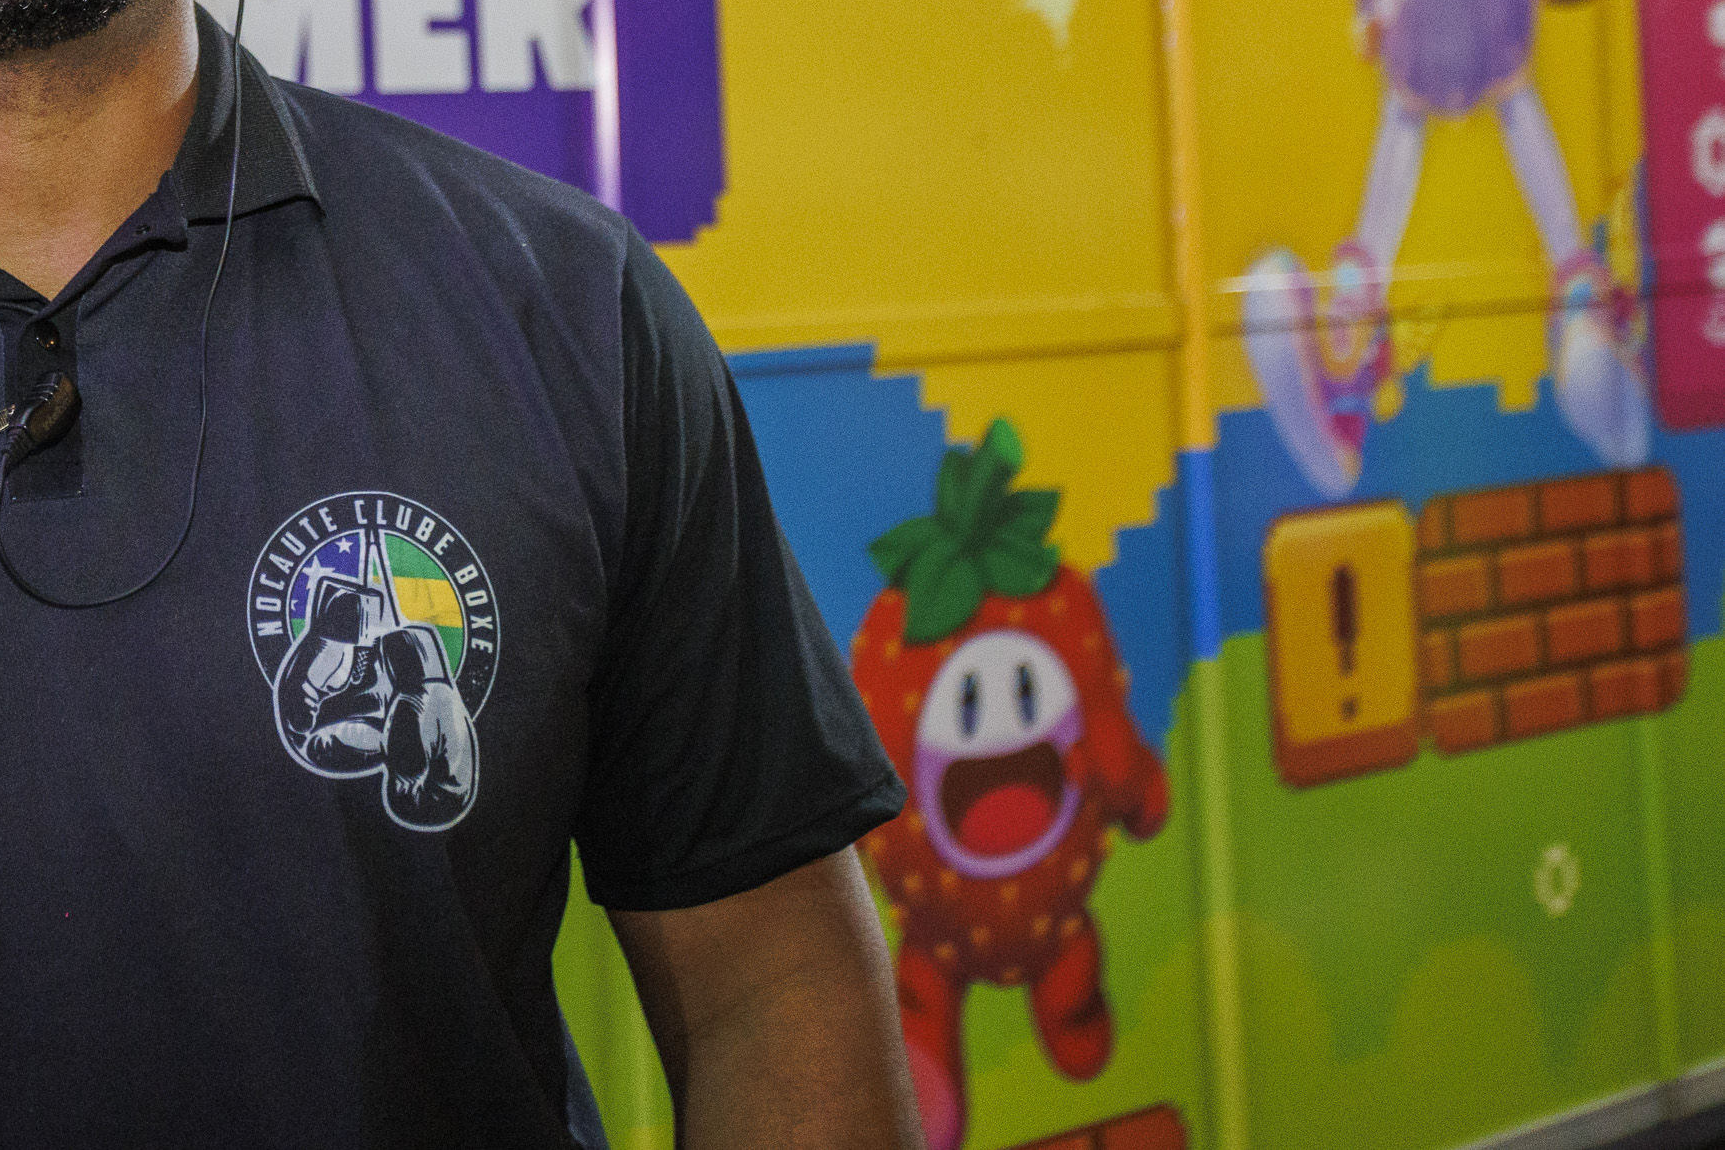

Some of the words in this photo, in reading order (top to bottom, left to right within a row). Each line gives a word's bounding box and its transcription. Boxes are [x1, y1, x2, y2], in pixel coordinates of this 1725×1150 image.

[255, 506, 338, 637] NOCAUTE
[353, 499, 456, 556] CLUBE
[454, 562, 494, 655] BOXE
